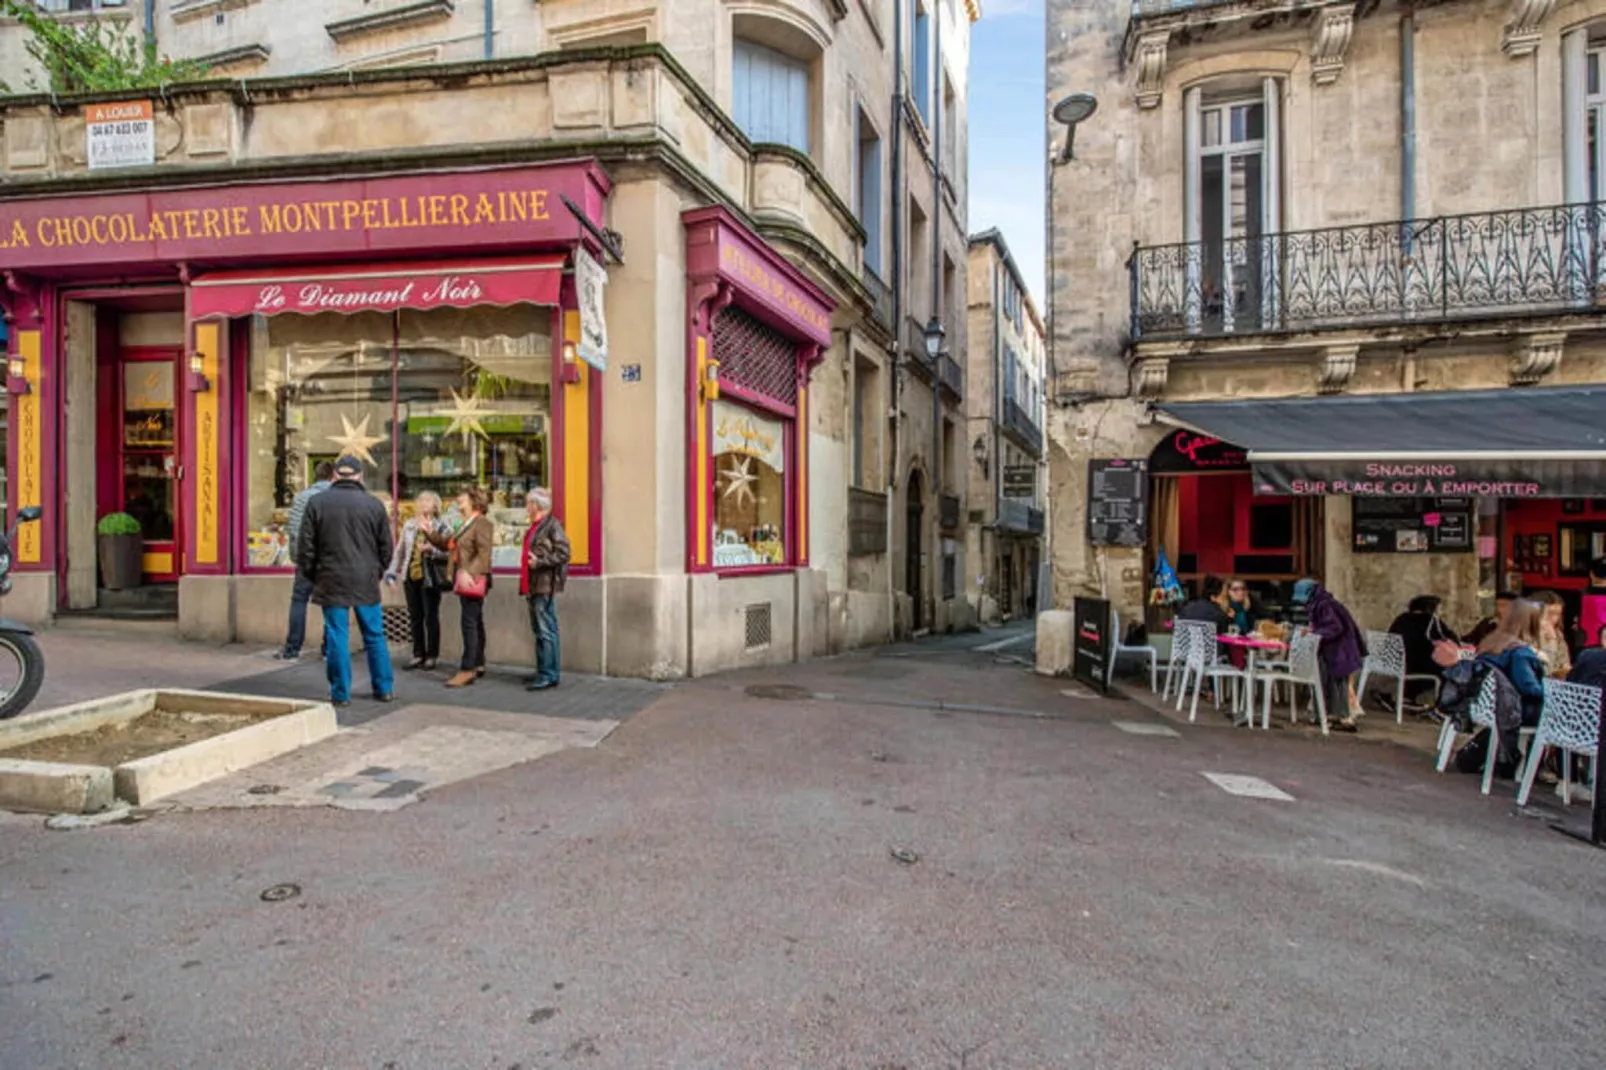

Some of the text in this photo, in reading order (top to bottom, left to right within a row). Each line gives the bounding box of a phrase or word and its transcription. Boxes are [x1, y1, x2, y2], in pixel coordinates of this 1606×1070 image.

[37, 206, 252, 247] CHOCOLATERIE
[259, 190, 550, 234] MONTPELLIERAINE
[255, 276, 483, 309] Le Diamant Noir
[23, 402, 34, 554] CHOCOLATIE
[1333, 480, 1384, 494] PLACE
[1392, 480, 1418, 493] OU
[1441, 480, 1540, 495] EMPORTER
